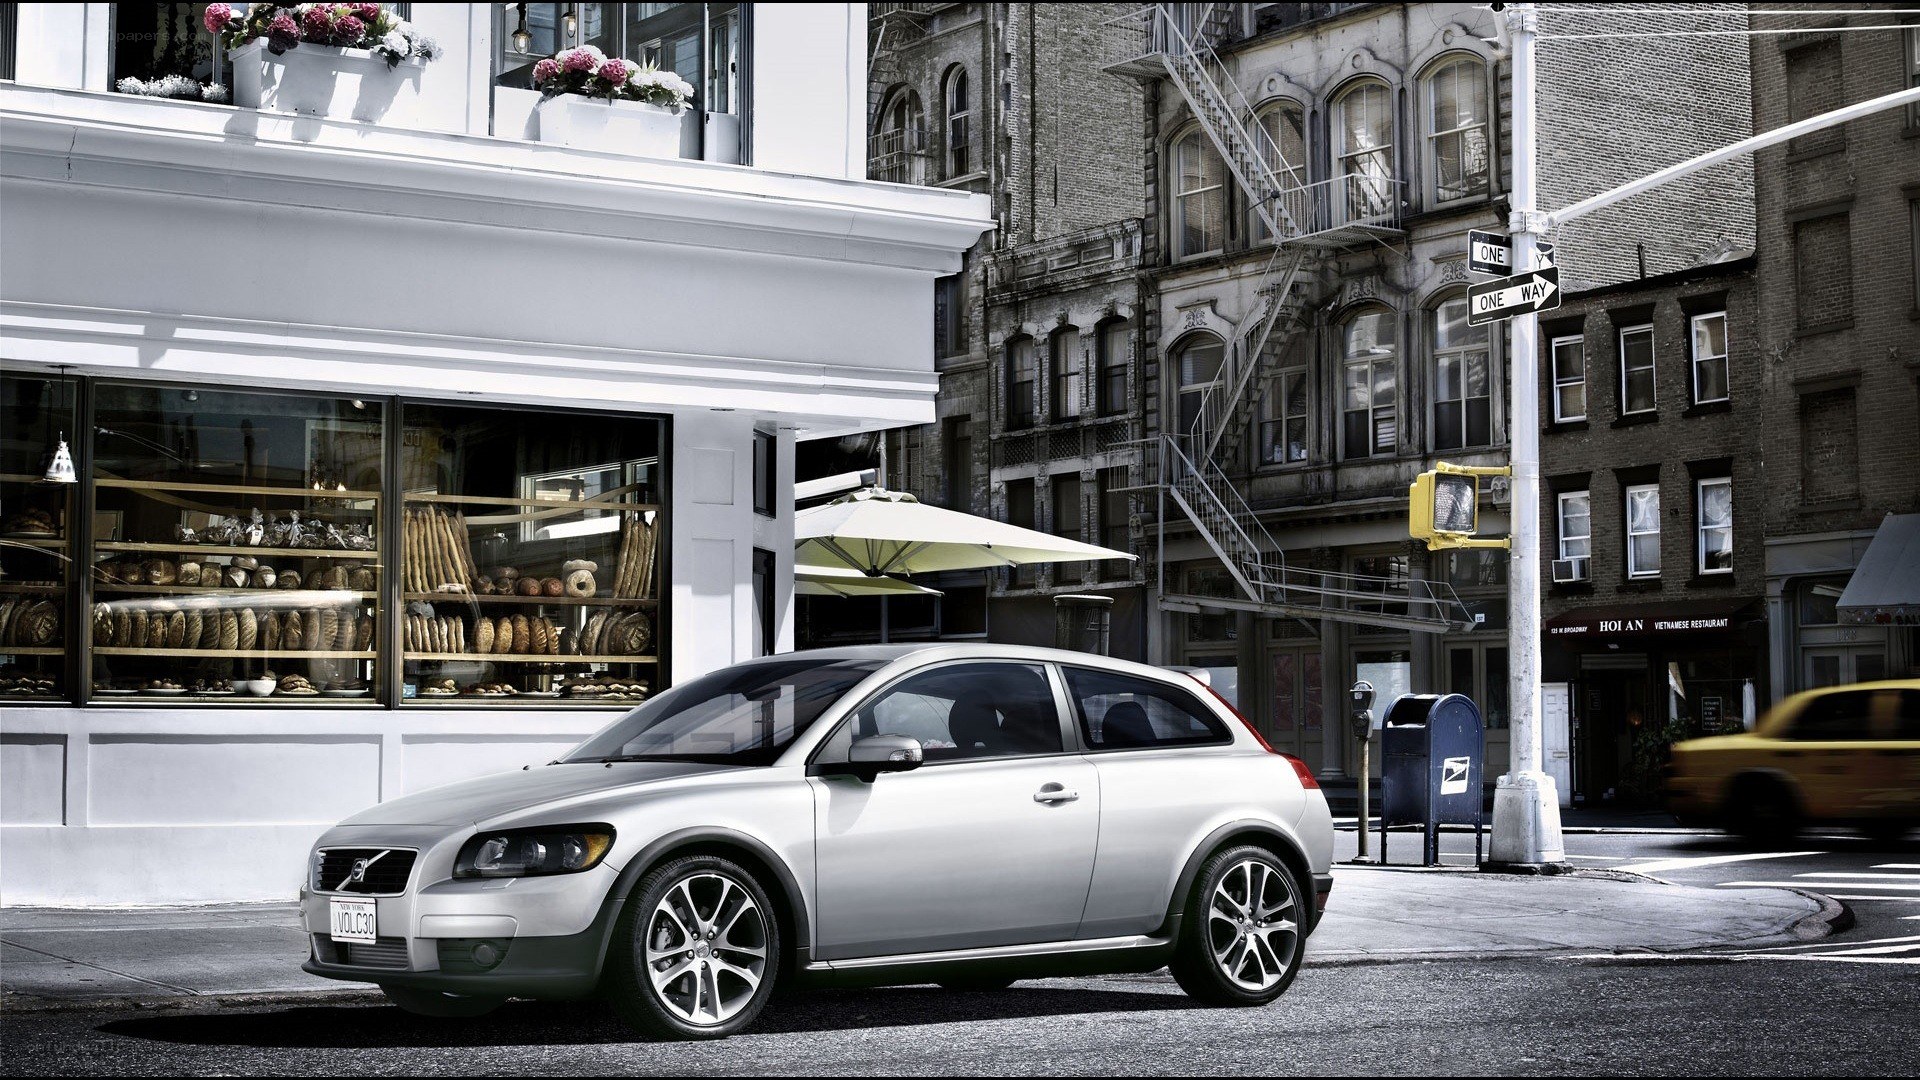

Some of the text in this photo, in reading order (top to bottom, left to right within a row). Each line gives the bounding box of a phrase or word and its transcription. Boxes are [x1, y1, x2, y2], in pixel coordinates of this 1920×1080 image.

[1481, 245, 1504, 263] ONE
[1480, 282, 1547, 310] ONE WAY
[1564, 626, 1588, 634] BROADWAY
[1599, 620, 1622, 632] HOI
[1625, 619, 1643, 631] AN
[1654, 620, 1690, 630] VIETNAMESE
[1690, 618, 1728, 629] RESTAURANT
[337, 912, 374, 935] VOLC30
